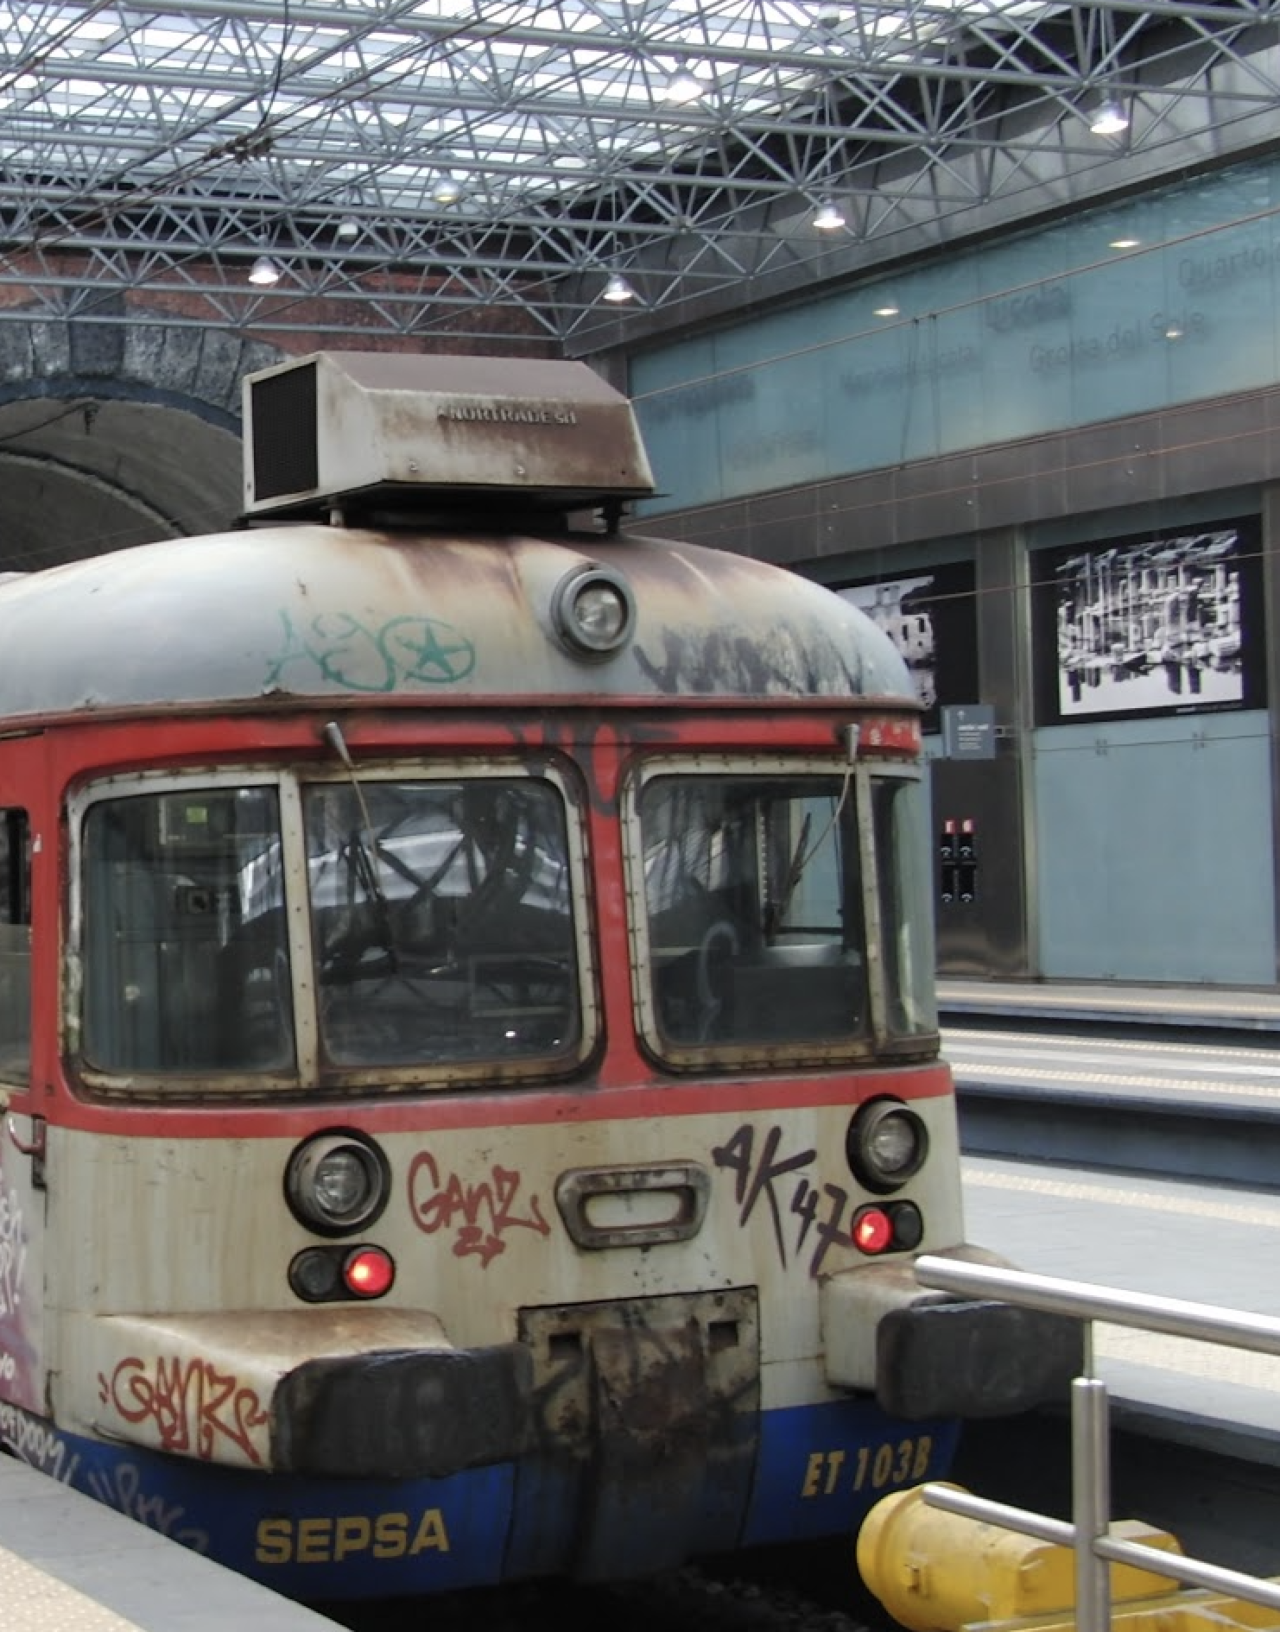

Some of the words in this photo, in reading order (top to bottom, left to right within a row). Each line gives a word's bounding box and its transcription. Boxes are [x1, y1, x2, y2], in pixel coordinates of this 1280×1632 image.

[790, 1179, 854, 1282] 47
[801, 1450, 846, 1497] ET
[852, 1435, 933, 1492] 103B
[254, 1507, 451, 1564] SEPSA
